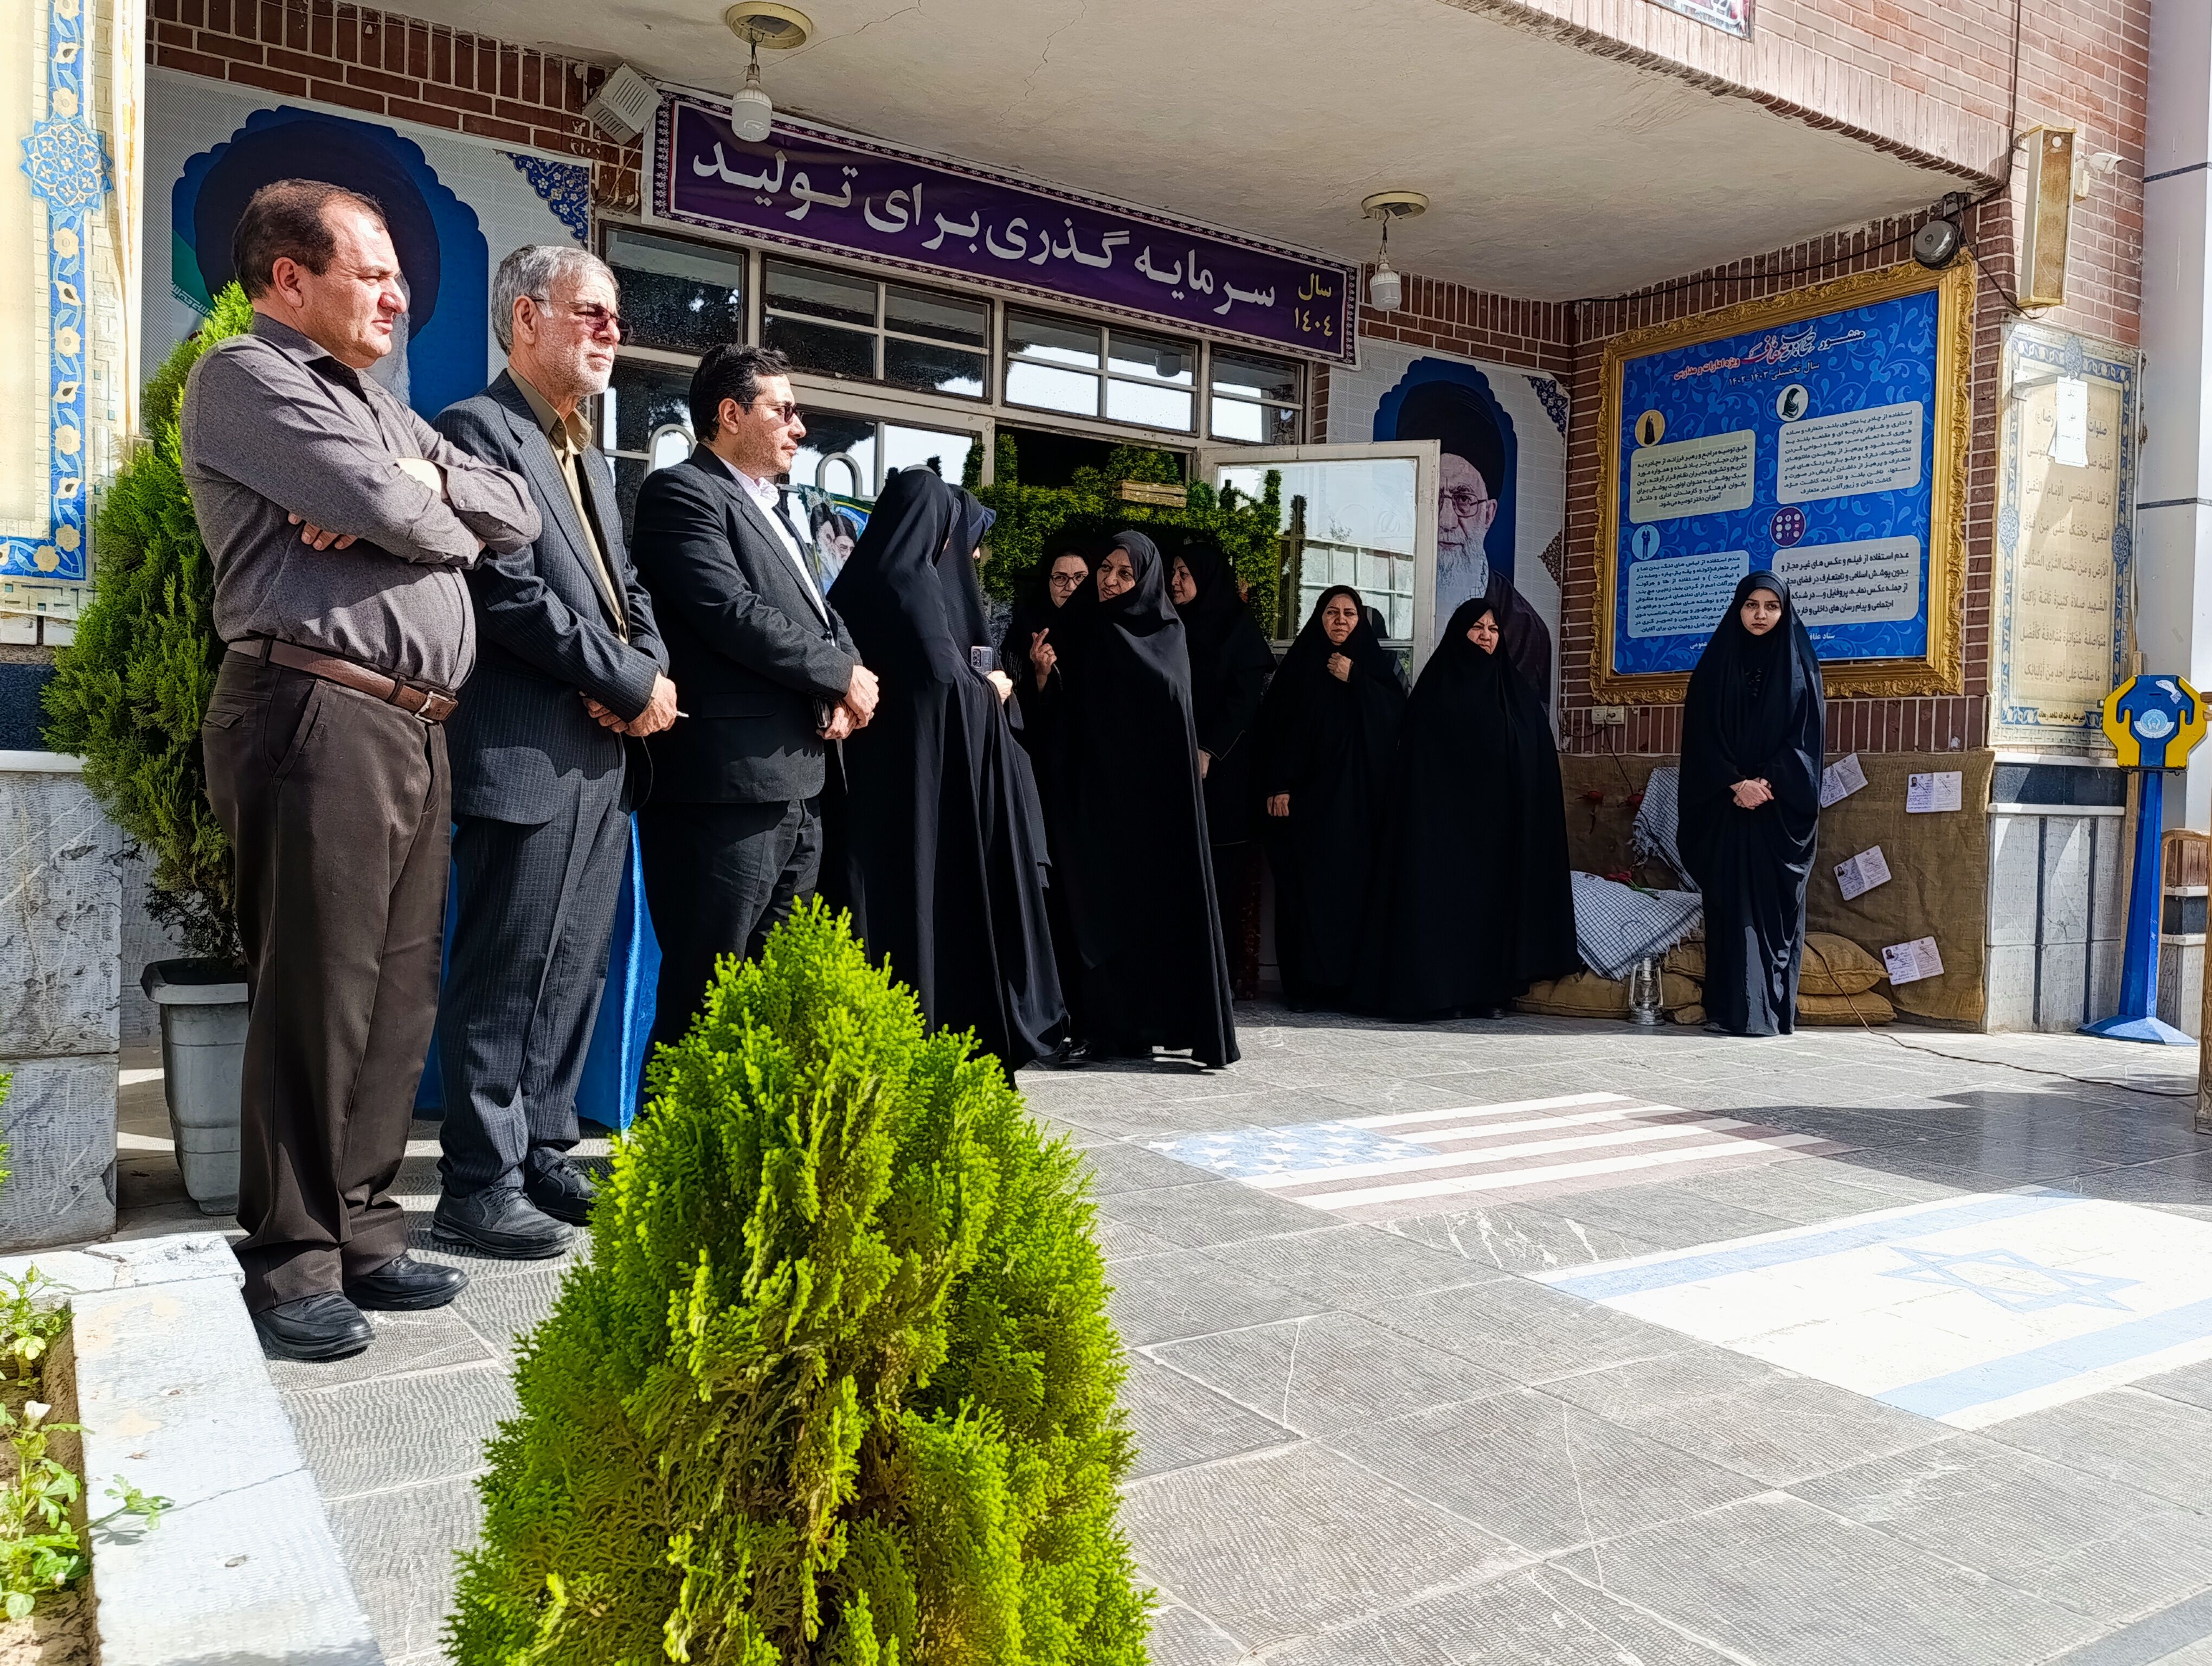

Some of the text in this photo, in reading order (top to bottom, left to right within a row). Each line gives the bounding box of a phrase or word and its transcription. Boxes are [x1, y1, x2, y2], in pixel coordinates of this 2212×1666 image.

[693, 141, 1275, 315] سرمایه گذری برای تولید
[1298, 272, 1332, 301] سال
[1817, 330, 1866, 351] منشور
[1741, 334, 1789, 365] عفاف
[1703, 358, 1724, 374] ادارات
[1725, 356, 1741, 370] ویژه
[1804, 361, 1819, 374] سال
[1674, 364, 1697, 381] مدارس
[1771, 366, 1801, 381] تحصیلی
[2087, 419, 2107, 438] صلوات
[1824, 556, 1841, 568] عکس
[1847, 554, 1862, 566] فیلم
[1862, 554, 1868, 564] از
[1869, 552, 1893, 561] استفاده
[1894, 552, 1909, 561] عدم
[1785, 562, 1798, 572] مجاز
[1799, 560, 1810, 571] غیر
[1811, 559, 1823, 569] های
